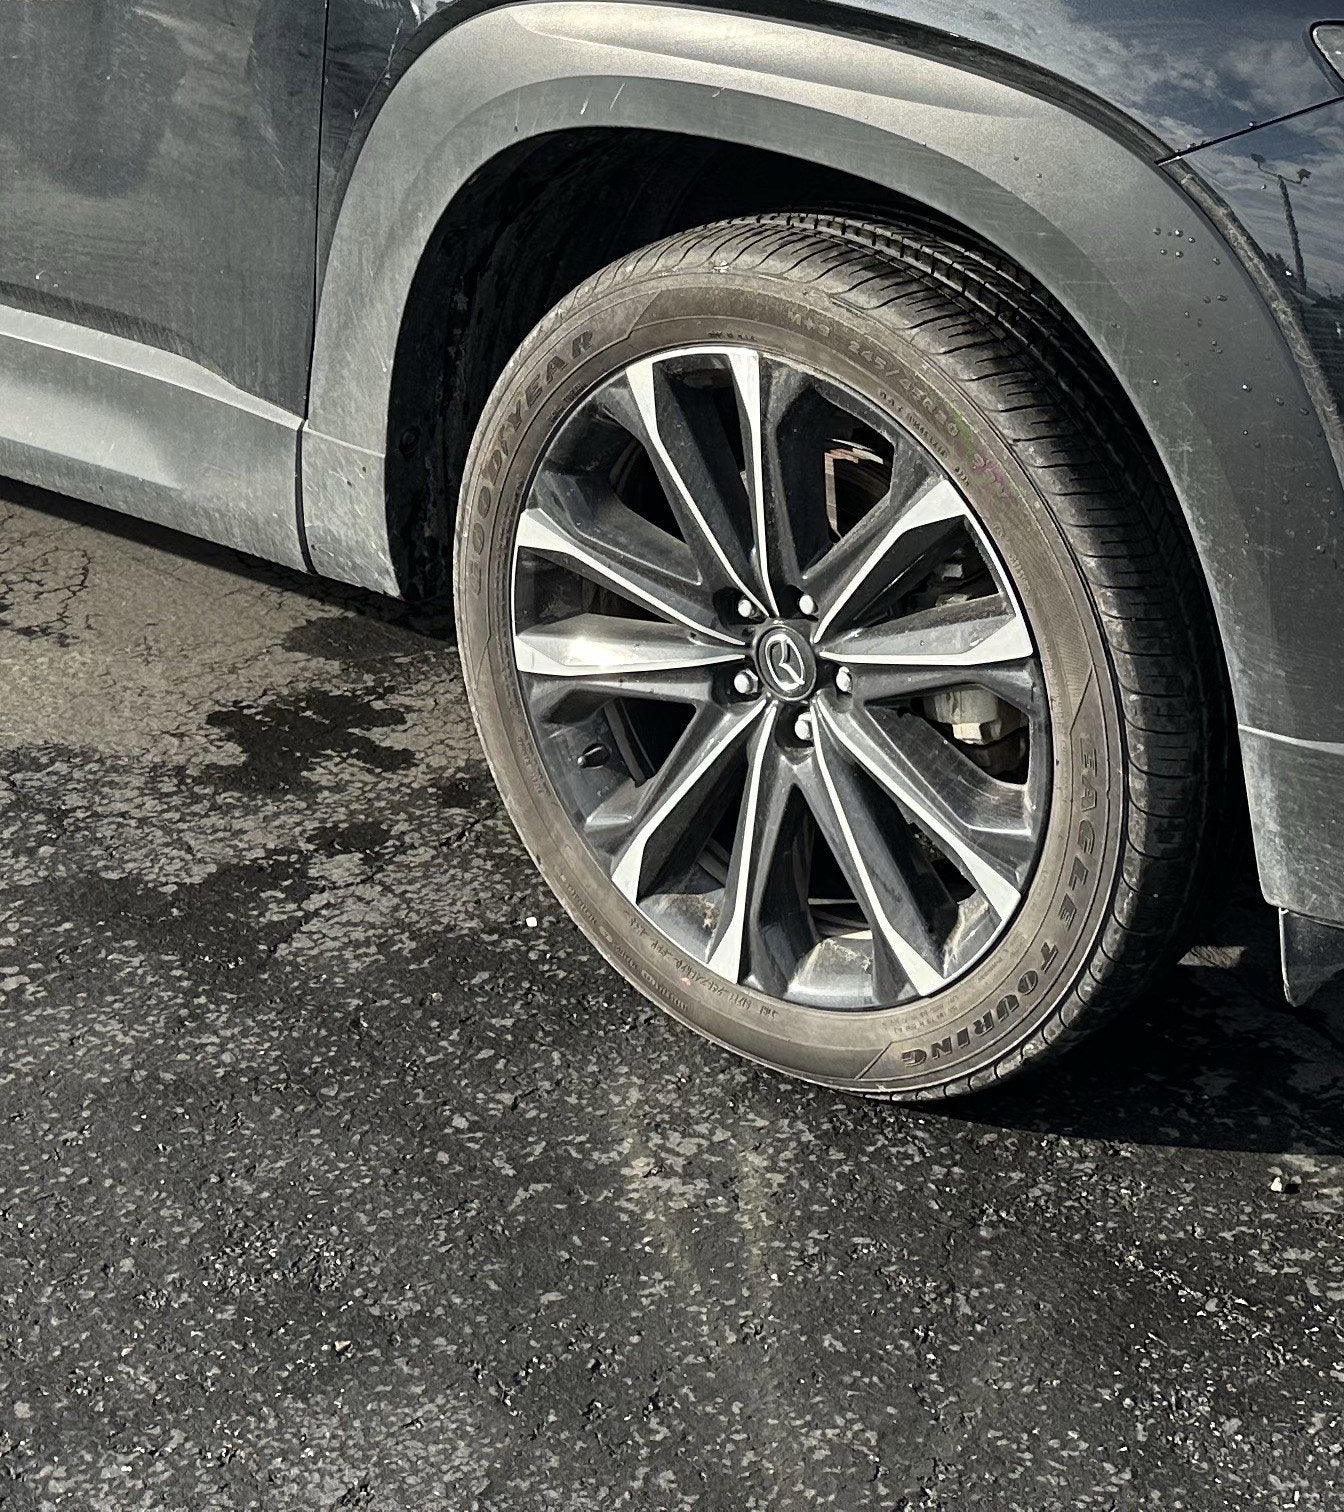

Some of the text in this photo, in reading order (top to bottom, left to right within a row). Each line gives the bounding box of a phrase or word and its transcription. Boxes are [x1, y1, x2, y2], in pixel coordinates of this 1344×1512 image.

[467, 330, 593, 596] GOODYEAR
[1059, 737, 1098, 931] EAGLE
[901, 941, 1059, 1066] TOURING
